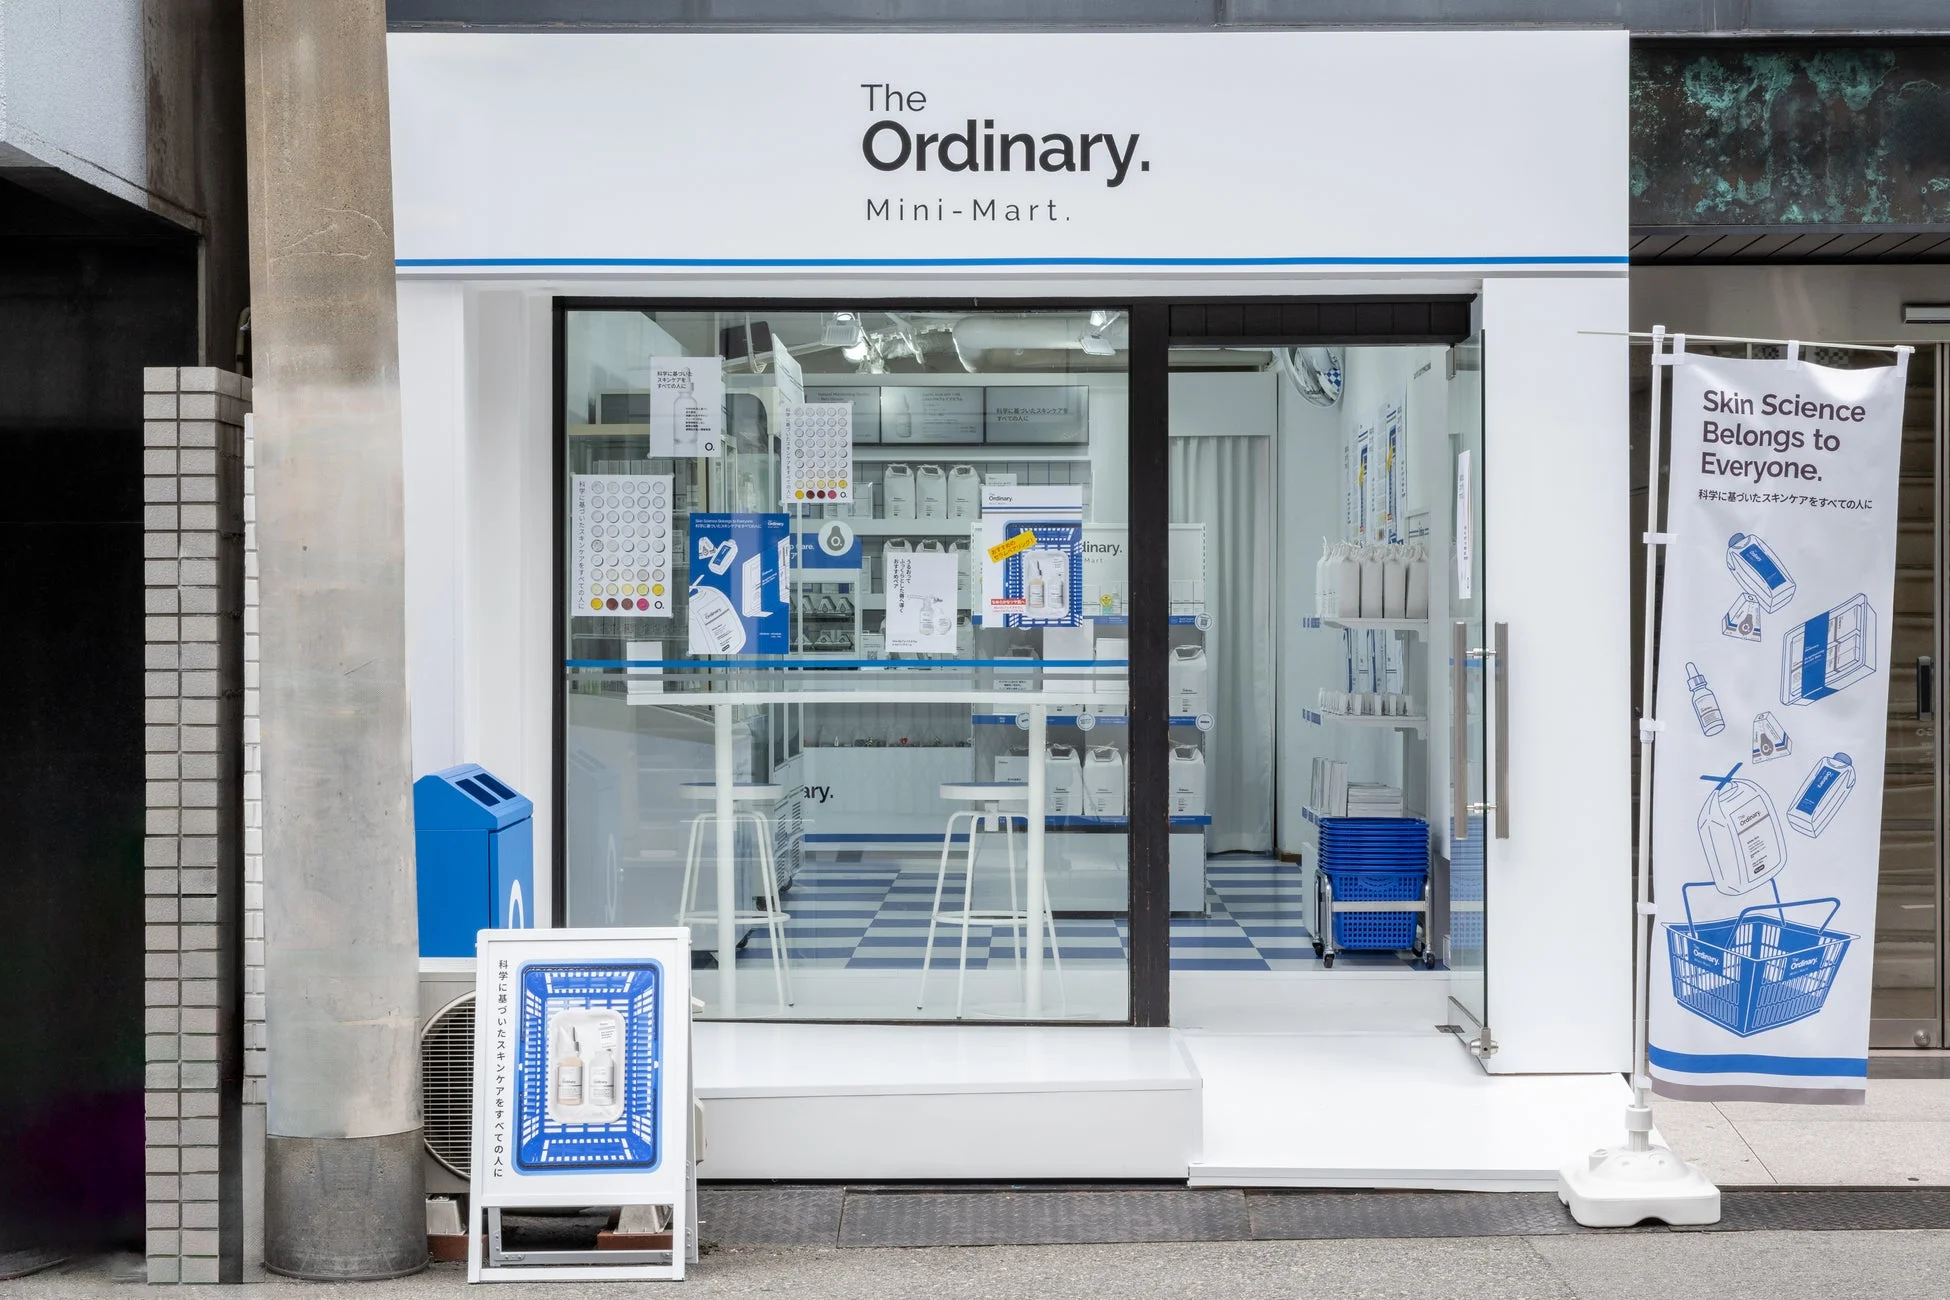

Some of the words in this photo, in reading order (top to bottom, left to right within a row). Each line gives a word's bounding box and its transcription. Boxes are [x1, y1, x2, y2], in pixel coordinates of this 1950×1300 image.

[861, 84, 927, 112] The
[862, 119, 1150, 187] Ordinary.
[866, 198, 1071, 222] Mini-Mart.
[1703, 390, 1754, 415] Skin
[1761, 394, 1866, 422] Science
[704, 442, 715, 451] O.
[1703, 421, 1805, 452] Belongs
[1814, 428, 1841, 452] to
[1701, 452, 1823, 484] Everyone.
[1698, 489, 1873, 510] 科学に基づいたスキンケアをすべての人に
[1082, 541, 1123, 556] dinary.
[654, 600, 665, 609] O.
[1693, 949, 1720, 965] Ordinary.
[493, 959, 509, 1178] 科学に基づいたスキンケアをすべての人に
